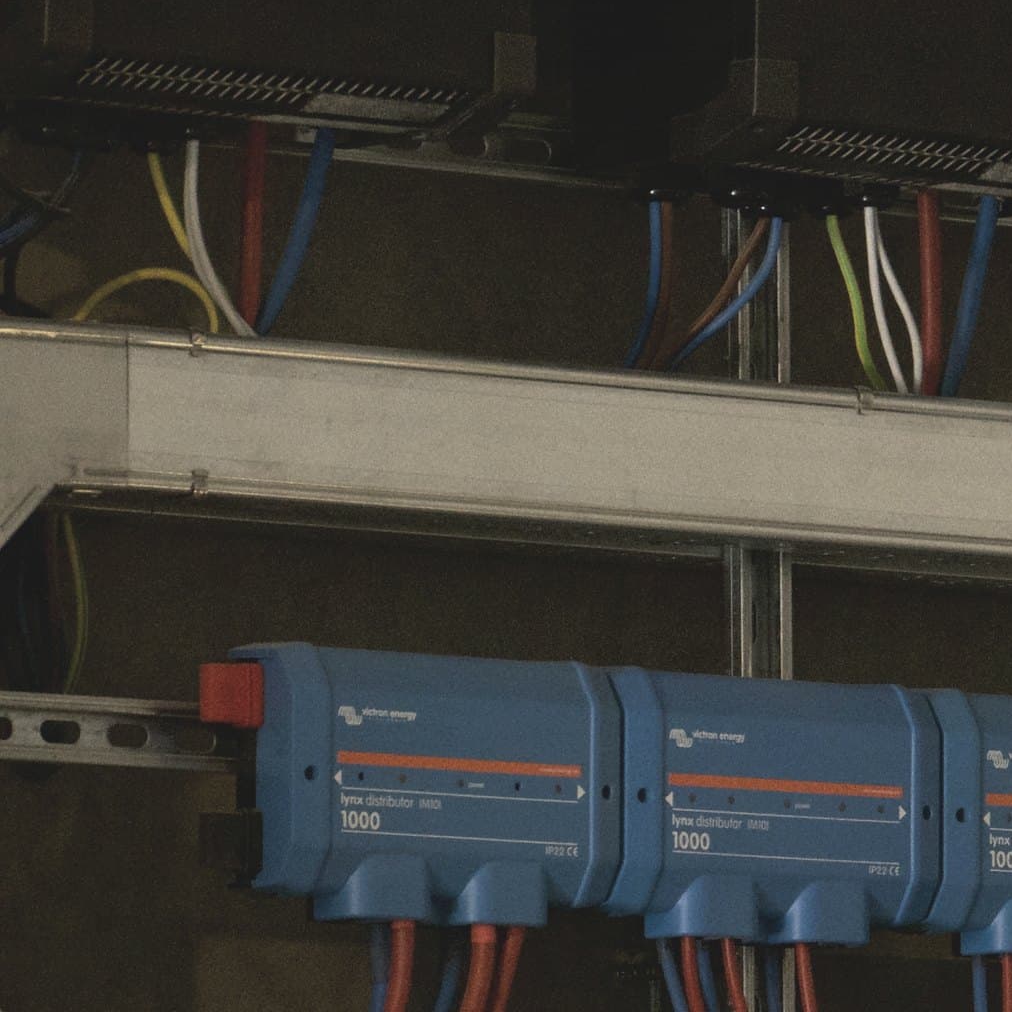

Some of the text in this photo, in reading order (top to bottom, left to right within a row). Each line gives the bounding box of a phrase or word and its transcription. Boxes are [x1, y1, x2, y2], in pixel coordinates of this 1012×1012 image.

[361, 707, 388, 717] victron
[390, 710, 416, 722] energy
[692, 729, 745, 744] victron energy
[341, 792, 363, 807] lynx
[365, 793, 414, 808] distributor
[341, 810, 380, 830] 1000
[672, 813, 694, 828] lynx
[695, 815, 742, 829] distributor
[672, 831, 710, 850] 1000
[989, 833, 1010, 848] lynx
